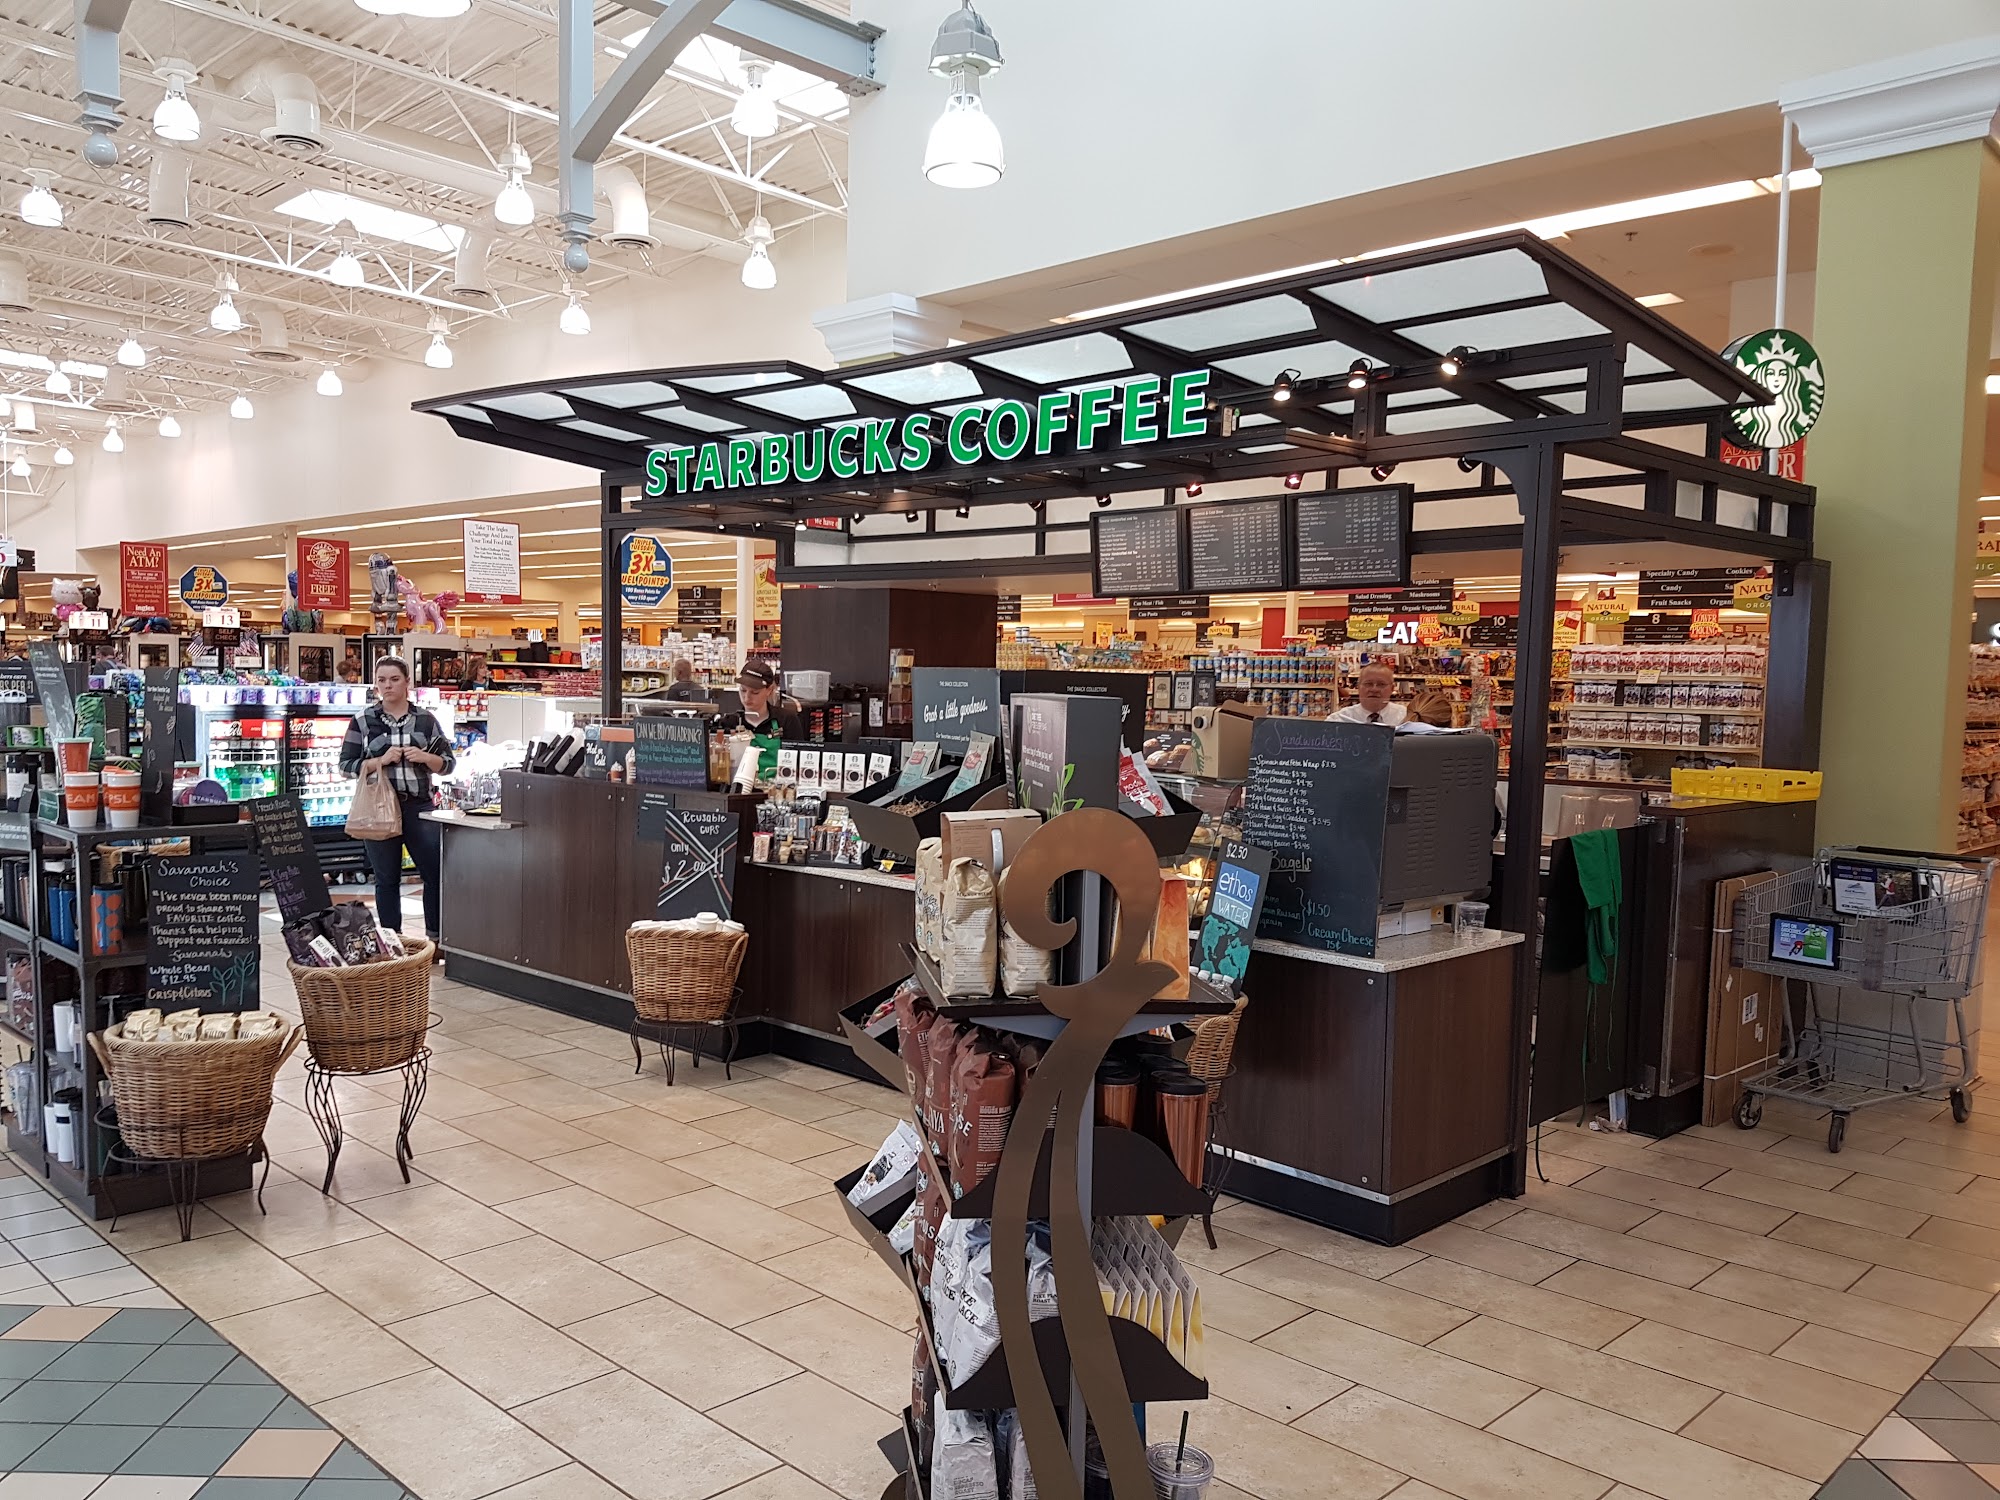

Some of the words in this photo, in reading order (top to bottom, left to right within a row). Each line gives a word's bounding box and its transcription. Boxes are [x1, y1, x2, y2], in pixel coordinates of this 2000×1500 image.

[645, 413, 932, 496] STARBUCKS
[947, 368, 1212, 465] COFFEE
[127, 546, 147, 557] Need
[149, 548, 161, 557] An
[129, 556, 159, 568] ATM?
[630, 553, 654, 575] 3X
[1646, 570, 1675, 578] Specialty
[1677, 569, 1699, 577] Candy
[1725, 567, 1753, 575] Cookies
[194, 578, 213, 592] 3X
[621, 575, 636, 584] UEL
[692, 587, 701, 598] 13
[1660, 584, 1683, 592] Candy
[1401, 604, 1421, 612] Organic
[1422, 604, 1447, 612] Vegetables
[1587, 603, 1627, 611] NATURAL
[1709, 598, 1734, 606] Organi
[1373, 605, 1395, 613] Dressing
[221, 614, 235, 626] 13
[1493, 615, 1506, 626] 10
[1651, 613, 1660, 624] 8
[1693, 613, 1717, 623] LOWER
[1378, 621, 1419, 644] EAT
[1691, 627, 1718, 636] PRICING
[923, 704, 938, 723] Grab
[939, 709, 944, 720] a
[945, 698, 959, 719] little
[960, 695, 988, 724] goodness.
[636, 721, 648, 739] CAN
[648, 723, 657, 740] WE
[680, 725, 702, 744] DRINK?
[586, 743, 599, 756] Hot
[594, 754, 607, 768] Cold
[1256, 754, 1279, 768] Spinach
[1254, 774, 1270, 784] Spicy
[1122, 780, 1144, 791] MOON
[1125, 784, 1149, 797] CHEESE
[108, 794, 132, 804] PSL
[1252, 793, 1263, 804] Egg
[255, 800, 275, 813] French
[275, 799, 291, 809] Roast
[1277, 805, 1292, 813] Swiss
[680, 811, 727, 824] Reusable
[700, 825, 720, 835] CUPS
[1226, 842, 1248, 860] $2.50
[158, 859, 239, 877] Savannah's
[1269, 849, 1312, 882] Bagels
[189, 876, 231, 888] Choice
[1219, 870, 1254, 902] ethos
[180, 892, 208, 901] never
[208, 891, 231, 901] been
[232, 892, 258, 901] more
[156, 903, 184, 915] proud
[185, 904, 195, 913] to
[196, 903, 224, 913] share
[225, 904, 242, 915] my
[1218, 898, 1249, 930] WATER
[1306, 899, 1331, 918] $1.50
[166, 914, 215, 924] FAVORITE
[216, 914, 247, 923] coffee
[151, 924, 187, 936] Thanks
[188, 924, 205, 934] for
[205, 924, 244, 938] helping
[1308, 922, 1341, 940] Cream
[1341, 927, 1374, 947] Cheese
[196, 937, 213, 945] our
[1325, 940, 1342, 951] 75¢
[149, 965, 183, 975] Whole
[183, 963, 211, 974] Bean
[160, 974, 197, 986] $12.95
